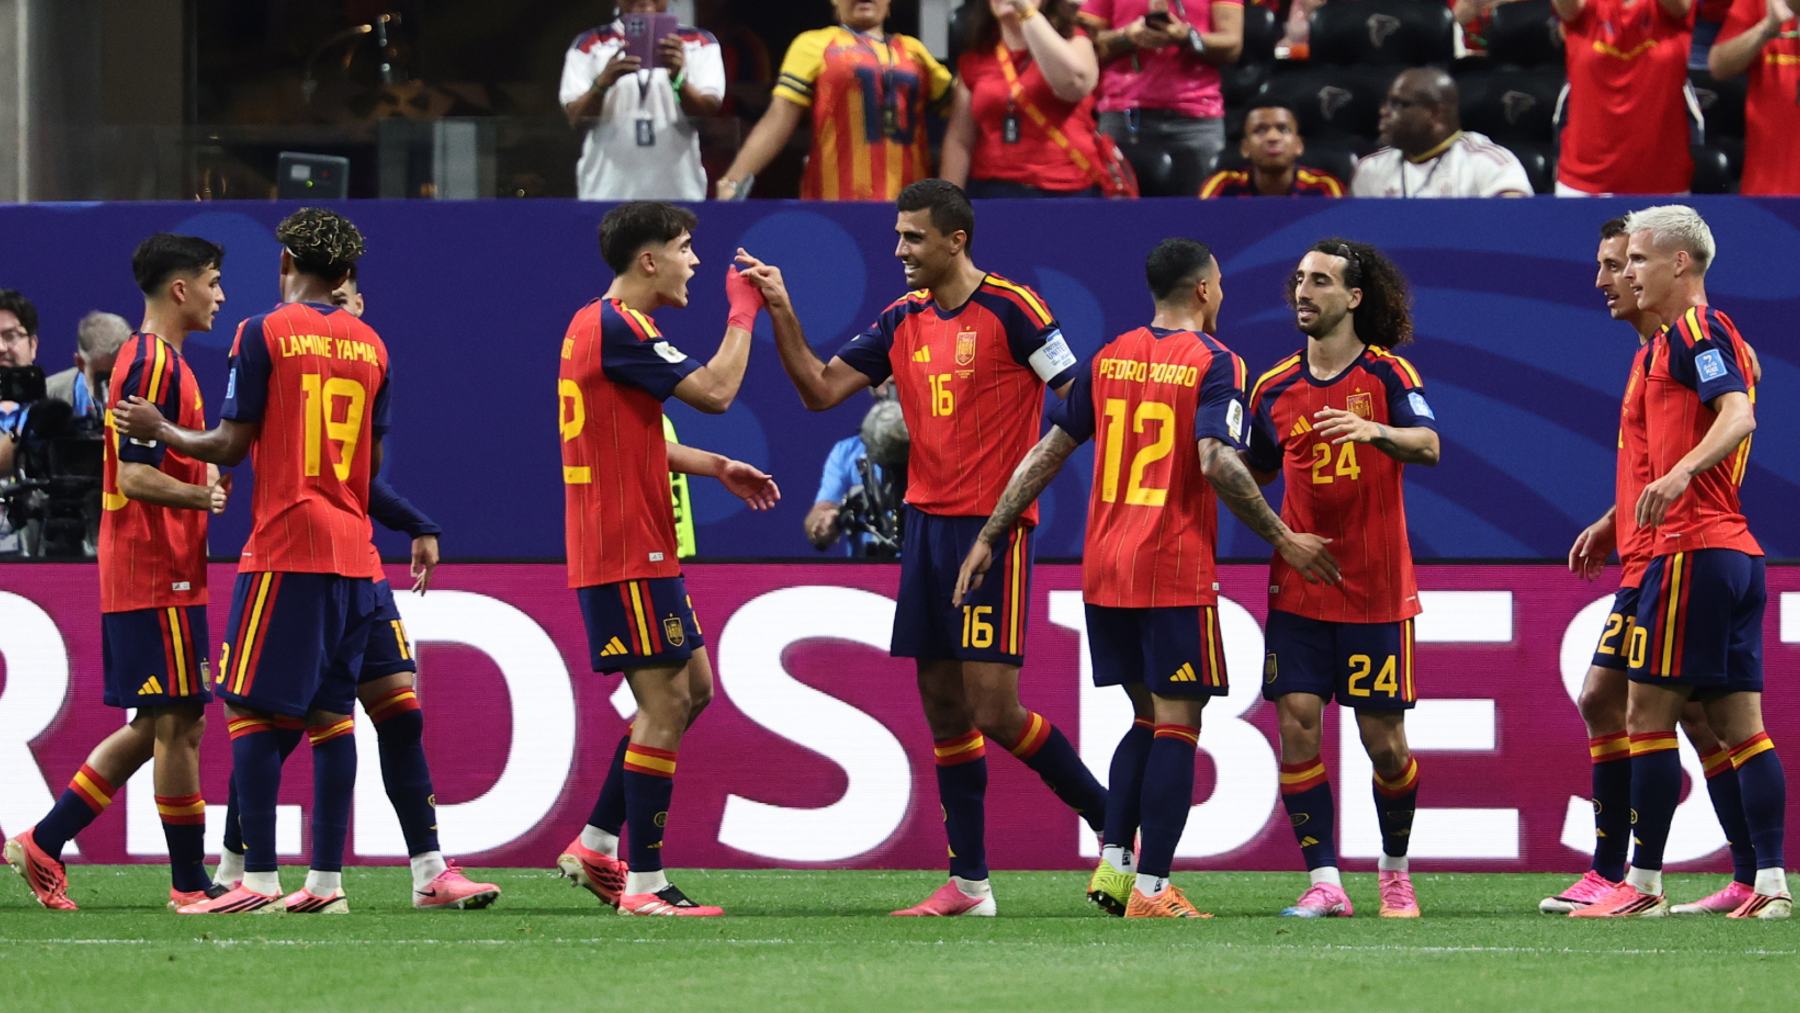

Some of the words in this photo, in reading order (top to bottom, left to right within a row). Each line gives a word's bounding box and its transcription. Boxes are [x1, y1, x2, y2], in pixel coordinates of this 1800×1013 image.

[279, 335, 332, 358] LAMINE
[336, 338, 378, 366] YAMAL
[1099, 358, 1148, 383] PEDRO
[929, 373, 954, 417] 16
[302, 374, 366, 481] 19
[1102, 398, 1175, 507] 12
[1312, 441, 1361, 485] 24
[962, 605, 994, 648] 16
[1597, 612, 1637, 657] 21
[1628, 626, 1648, 669] 0
[1348, 654, 1398, 698] 24
